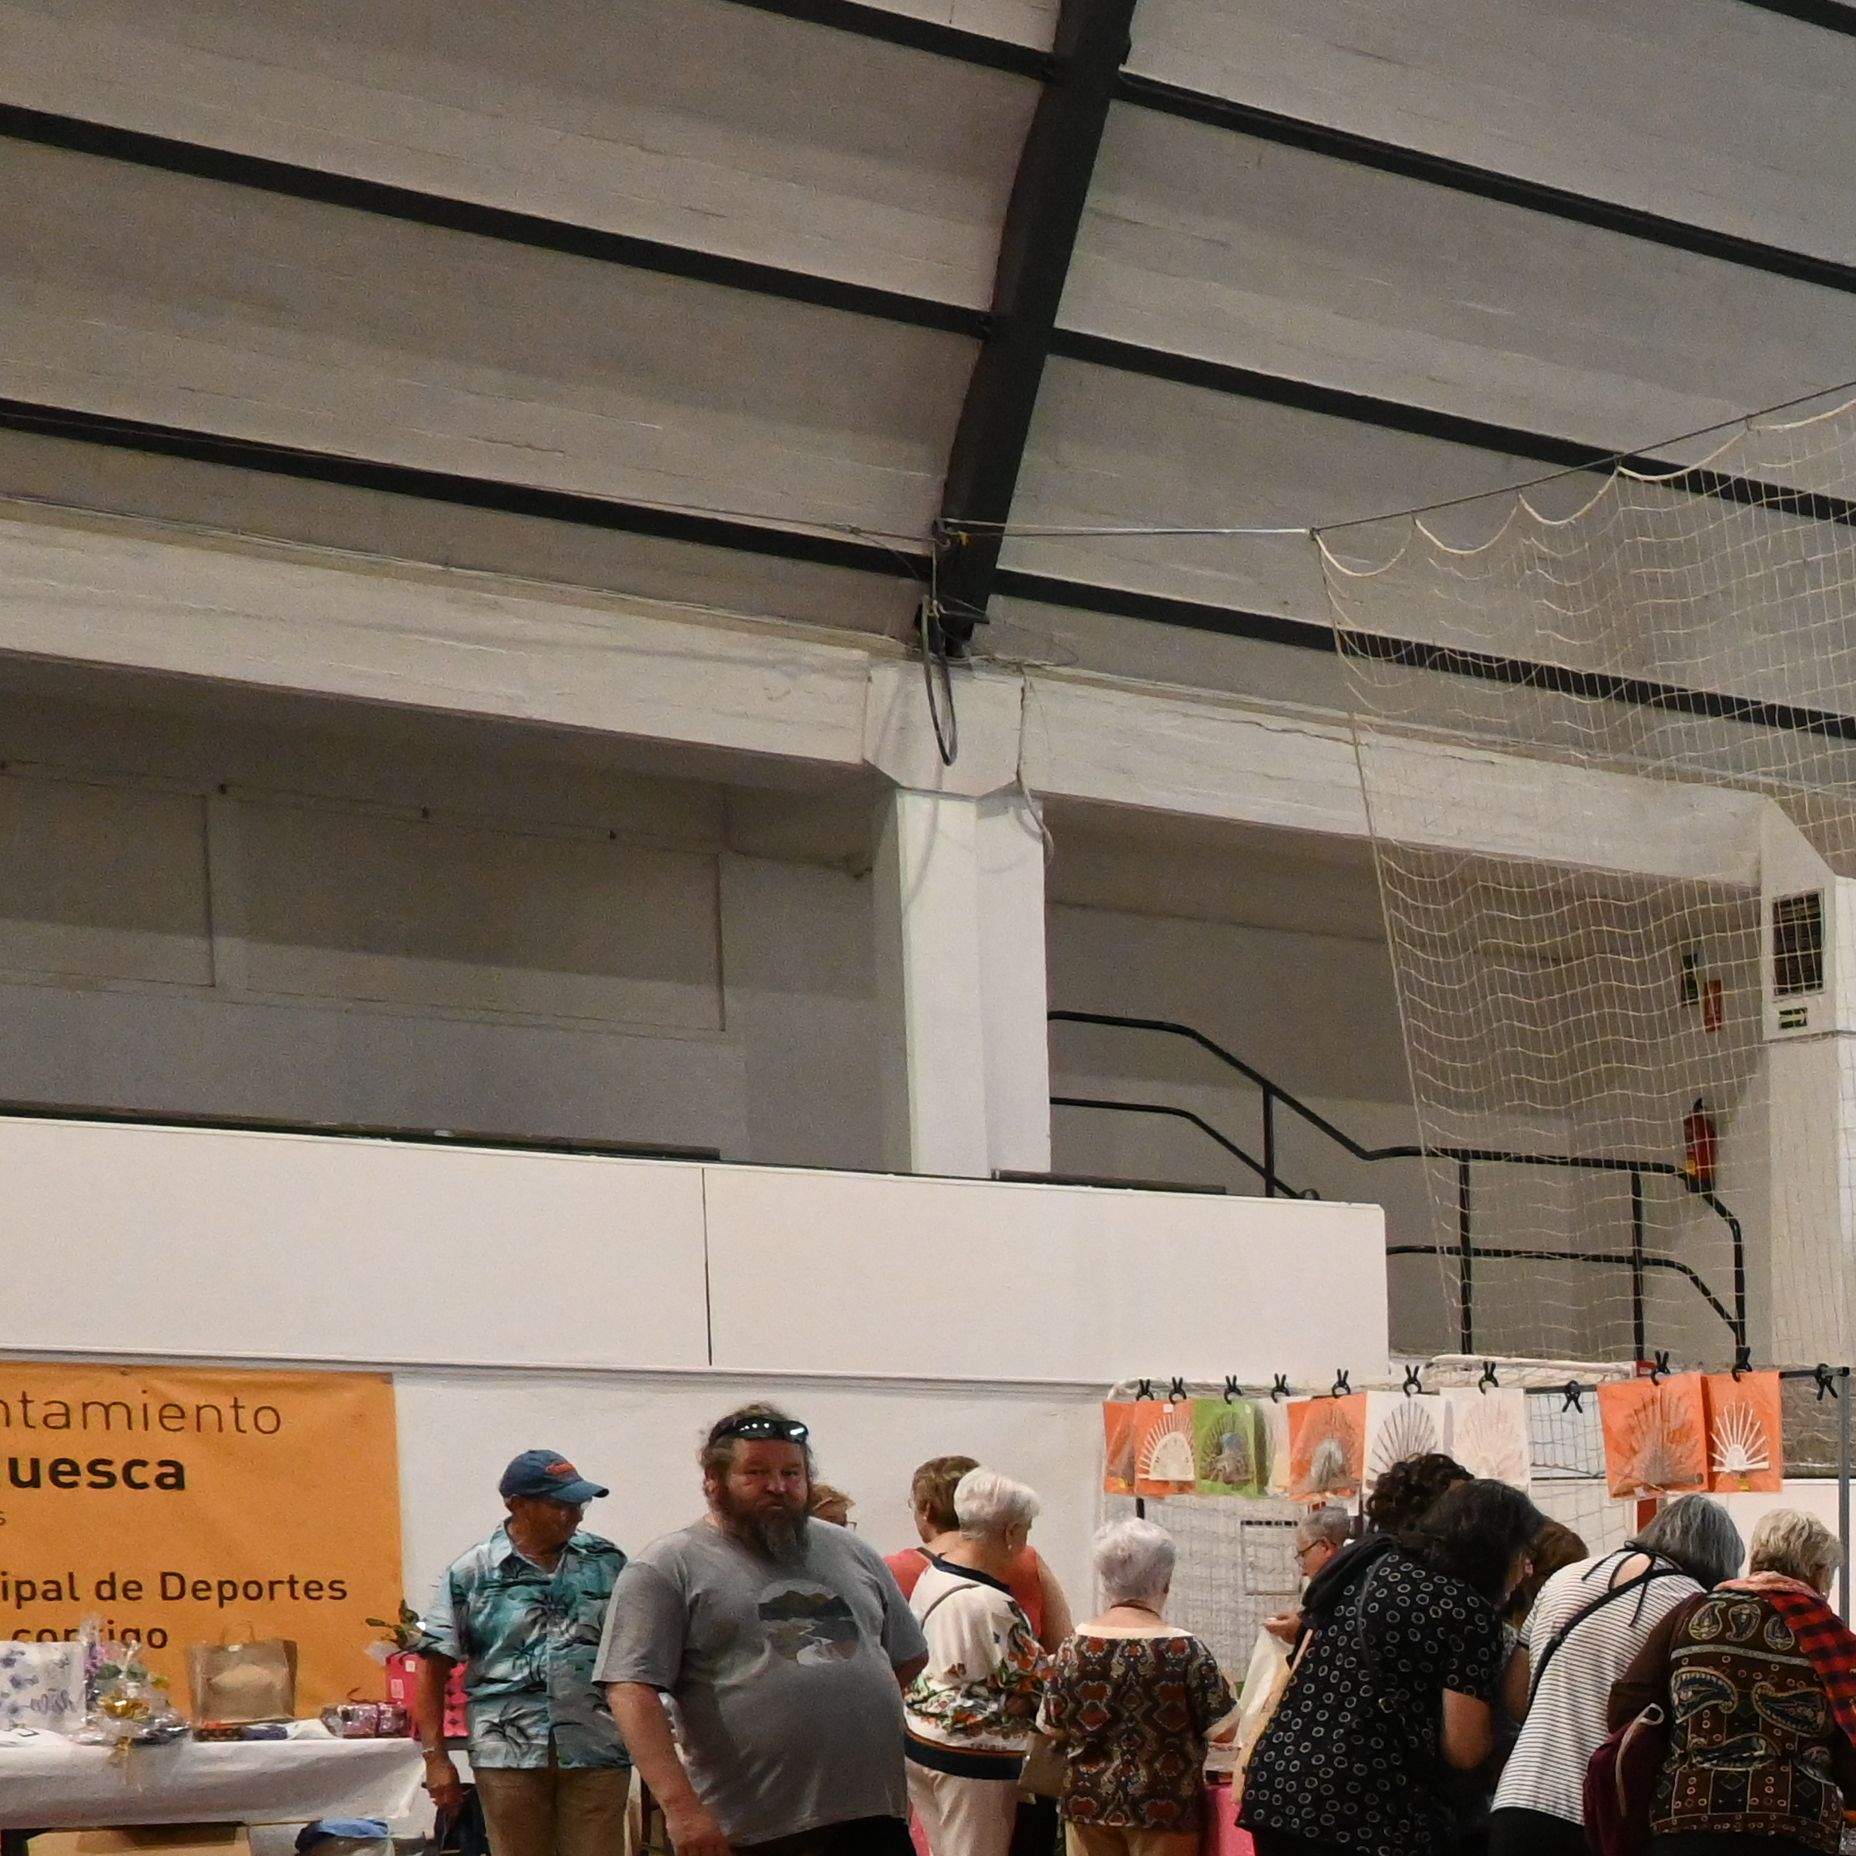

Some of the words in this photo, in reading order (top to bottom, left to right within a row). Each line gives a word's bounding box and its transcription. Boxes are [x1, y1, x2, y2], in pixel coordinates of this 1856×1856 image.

[8, 1456, 186, 1491] uesca
[0, 1570, 80, 1610] ipal
[95, 1571, 143, 1602] de
[160, 1571, 348, 1609] Deportes
[11, 1618, 169, 1650] conigo
